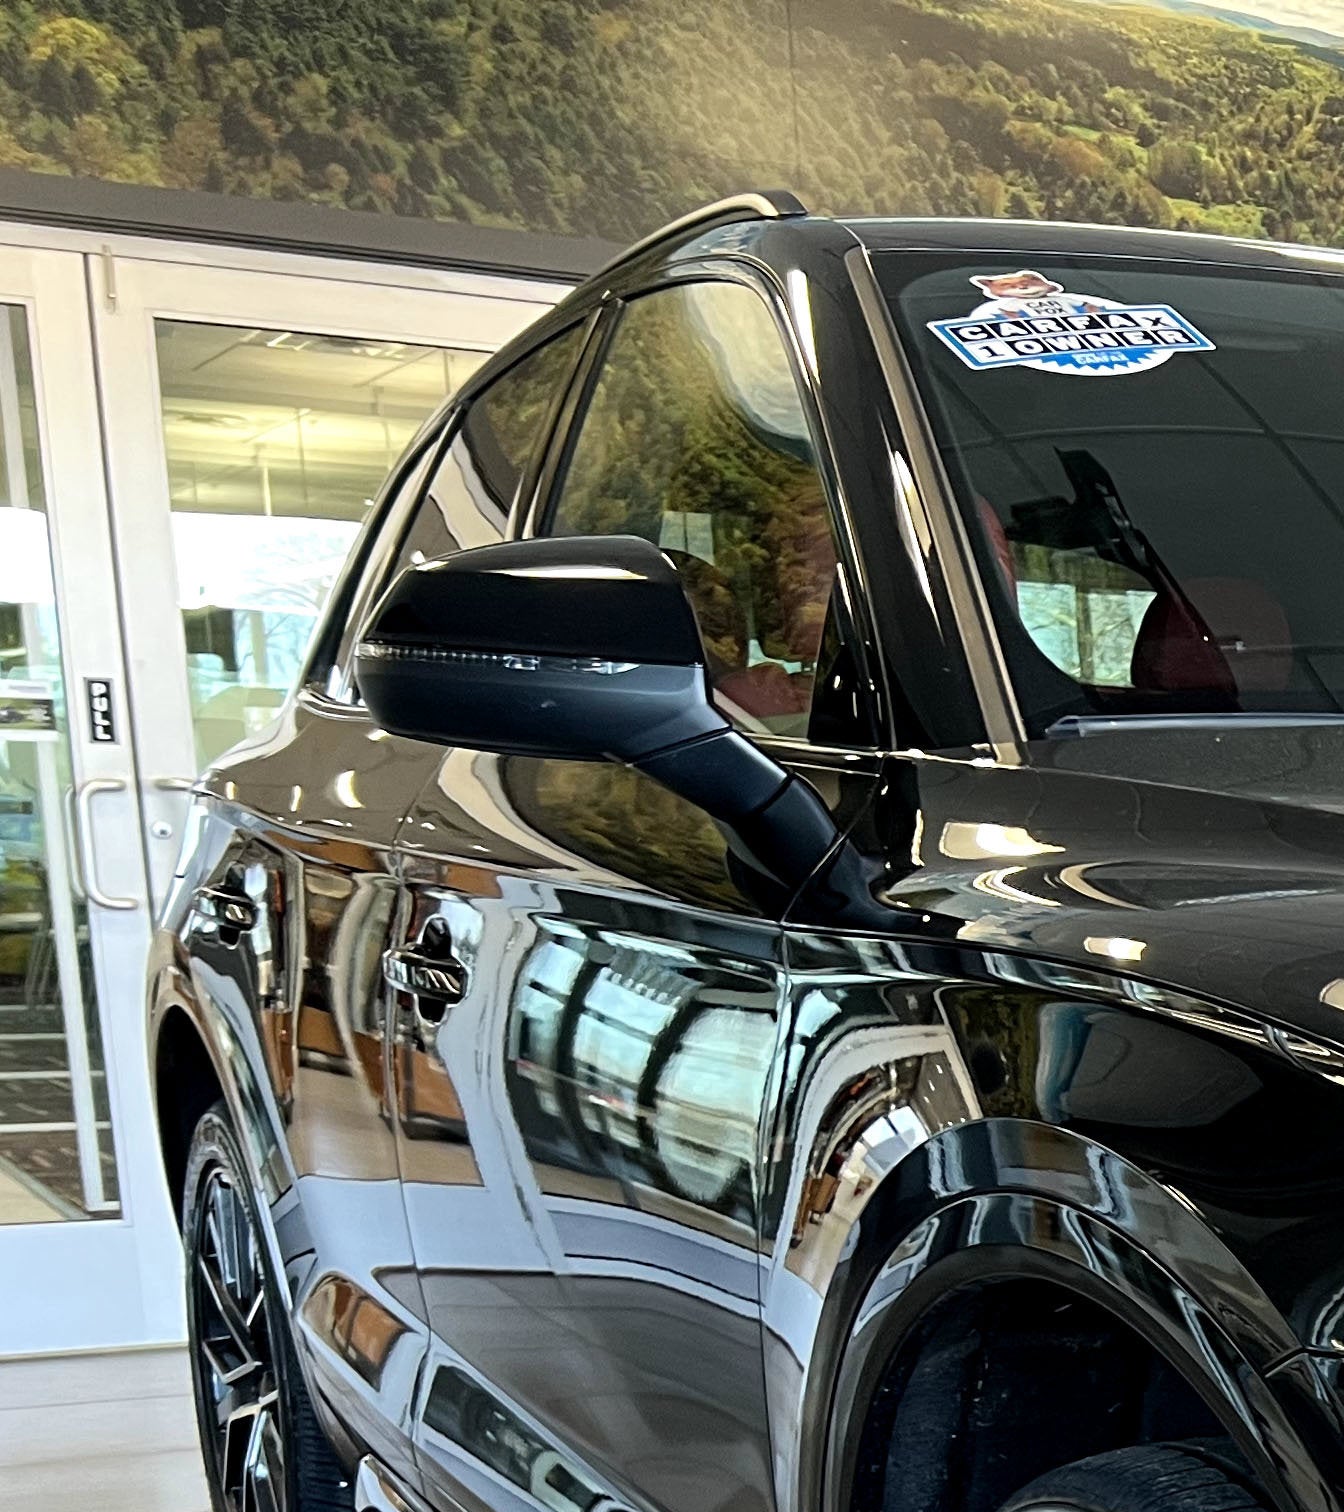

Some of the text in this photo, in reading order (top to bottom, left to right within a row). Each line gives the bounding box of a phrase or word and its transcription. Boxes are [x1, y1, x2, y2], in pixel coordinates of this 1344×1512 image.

[956, 314, 1175, 342] CARFAX
[978, 330, 1190, 358] 1 OWNER
[90, 682, 112, 740] PULL
